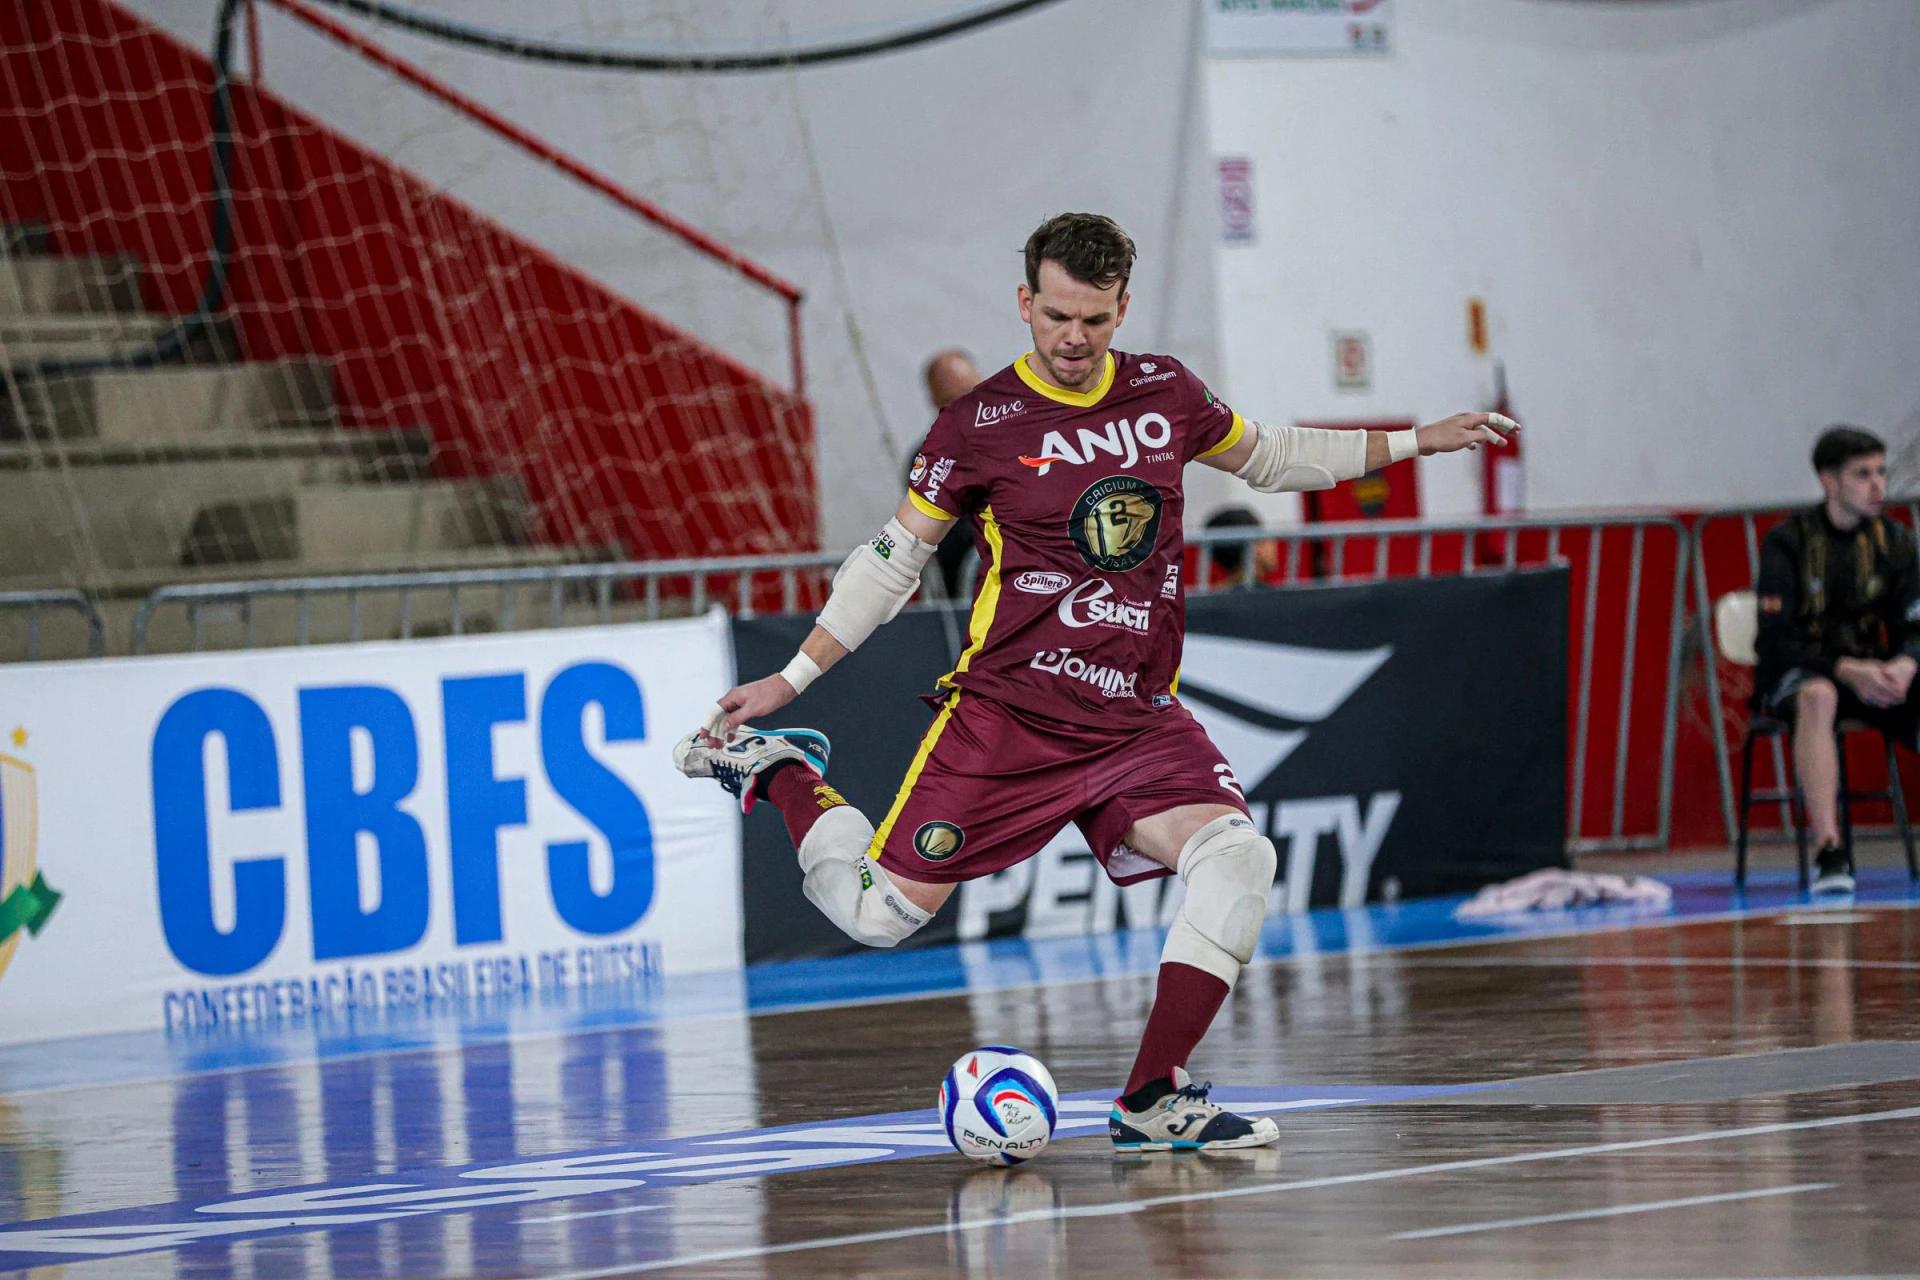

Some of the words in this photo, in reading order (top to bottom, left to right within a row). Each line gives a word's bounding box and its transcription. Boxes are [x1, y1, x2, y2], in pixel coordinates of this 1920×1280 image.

[1037, 412, 1171, 477] ANJO
[1145, 451, 1175, 464] TINTAS
[1085, 480, 1144, 507] CRICIUM
[1109, 499, 1128, 526] 2
[151, 660, 656, 978] CBFS
[964, 1129, 1046, 1150] PENALTY
